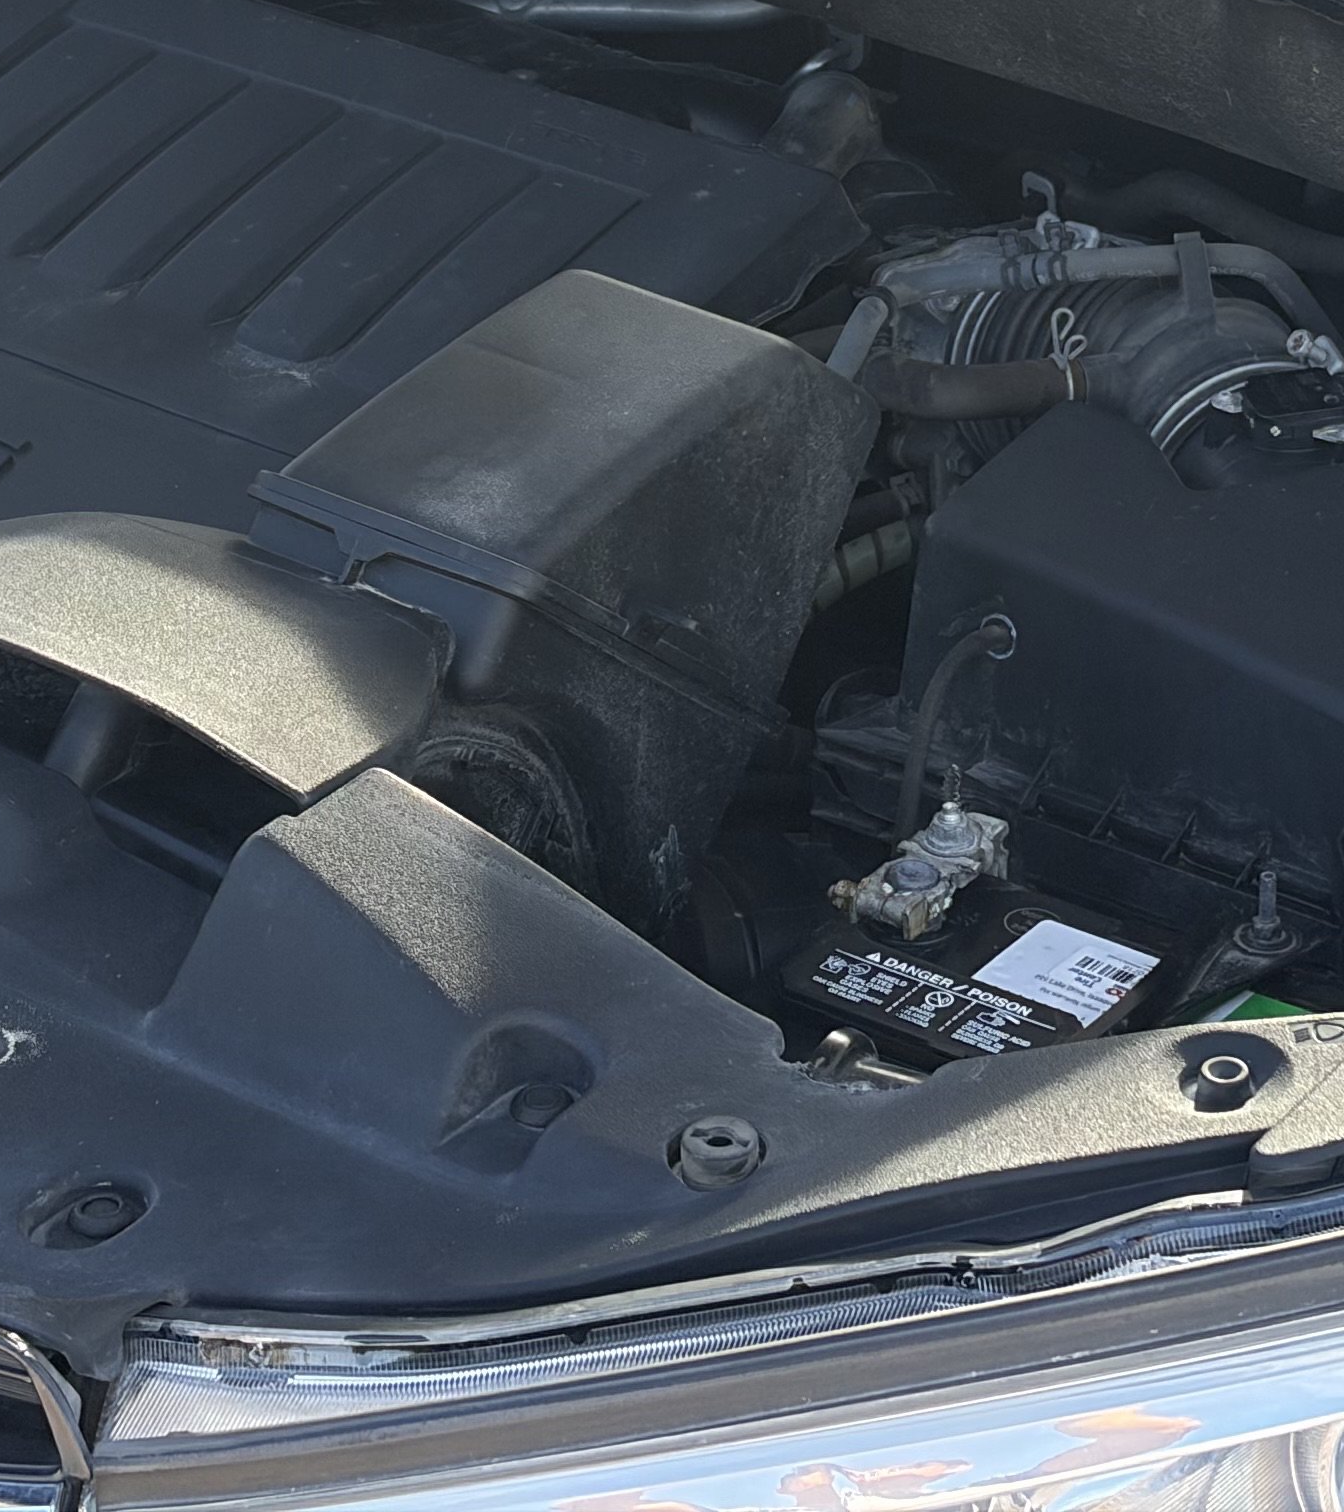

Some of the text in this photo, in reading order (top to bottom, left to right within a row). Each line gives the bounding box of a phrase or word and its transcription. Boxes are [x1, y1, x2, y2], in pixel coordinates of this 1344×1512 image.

[876, 972, 908, 987] SHIELD
[883, 957, 954, 988] DANGER
[967, 988, 1033, 1017] POISON
